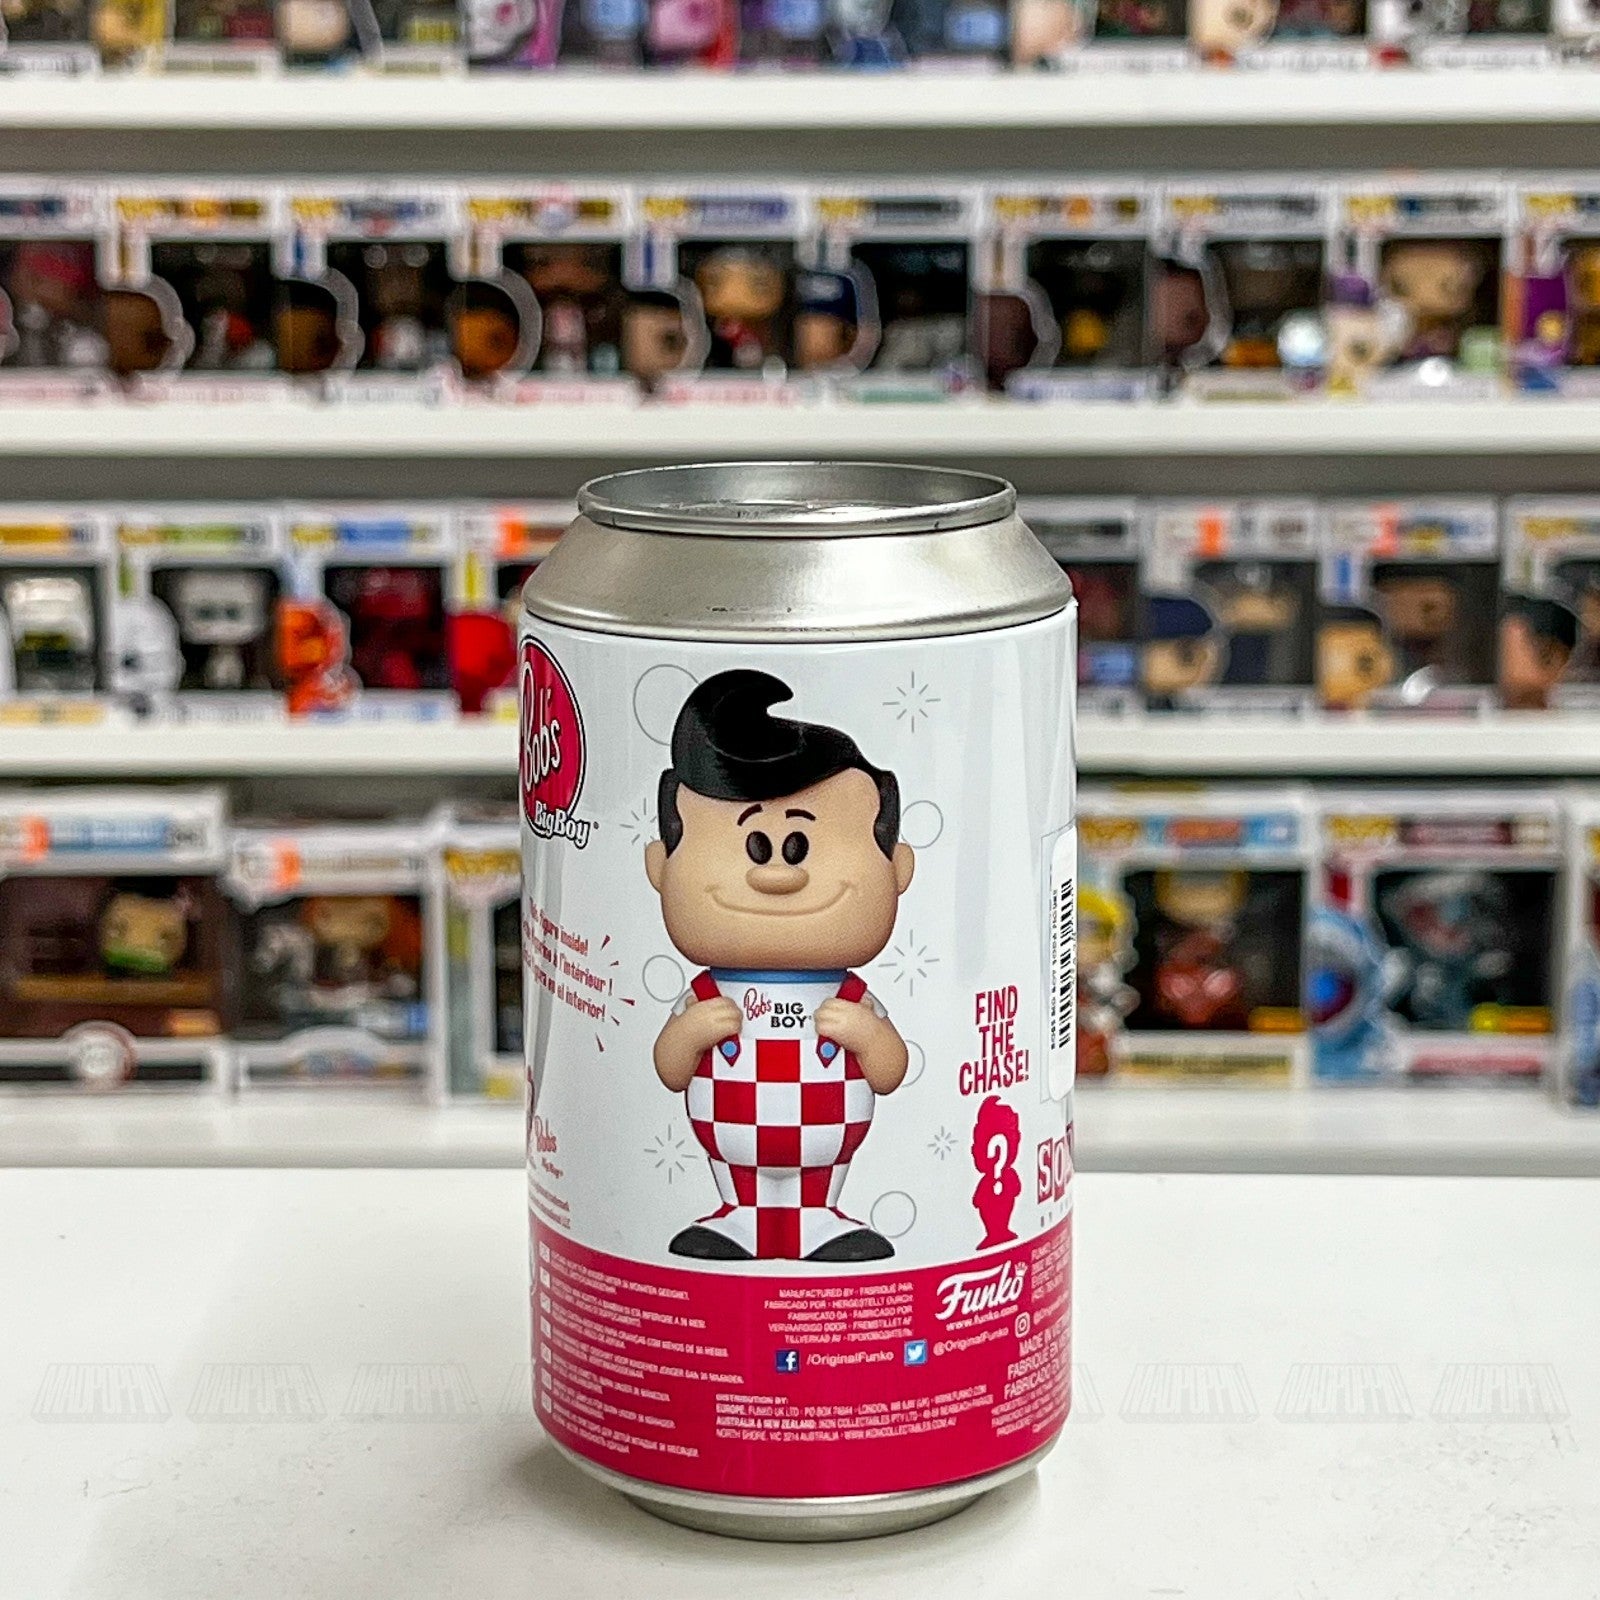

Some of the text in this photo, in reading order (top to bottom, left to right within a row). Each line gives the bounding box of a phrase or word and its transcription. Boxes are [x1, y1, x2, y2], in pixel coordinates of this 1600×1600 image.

[521, 661, 561, 792] Bob's
[565, 985, 605, 1023] interior!
[770, 1015, 807, 1028] BOY
[774, 1002, 804, 1015] BIG
[975, 985, 1019, 1026] FIND
[978, 1019, 1016, 1059] THE
[959, 1048, 1030, 1096] CHASE!
[934, 1260, 1026, 1320] Funko
[946, 1304, 1019, 1331] www.funko.com
[806, 1351, 894, 1367] /OriginalFunko
[933, 1327, 1009, 1356] @OriginalFunko
